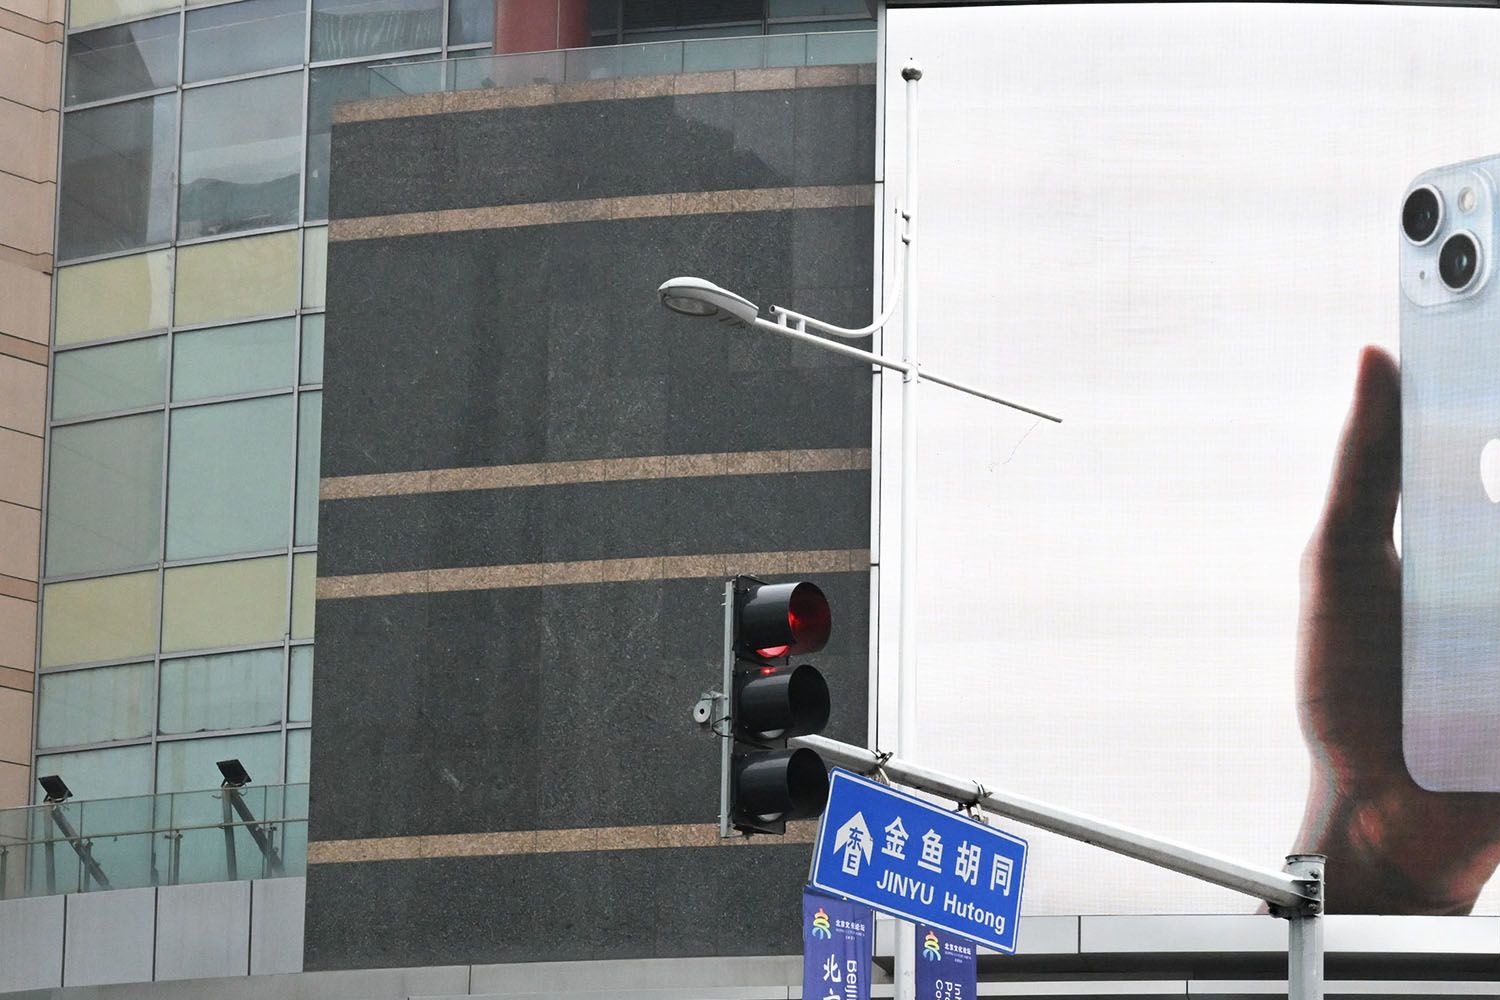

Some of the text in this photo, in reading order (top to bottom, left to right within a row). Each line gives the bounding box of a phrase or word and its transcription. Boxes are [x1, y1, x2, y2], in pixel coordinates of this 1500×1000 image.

[848, 826, 864, 851] 东
[849, 854, 858, 867] E
[881, 816, 1014, 897] 金鱼胡同
[876, 869, 1006, 935] JINYU Hutong
